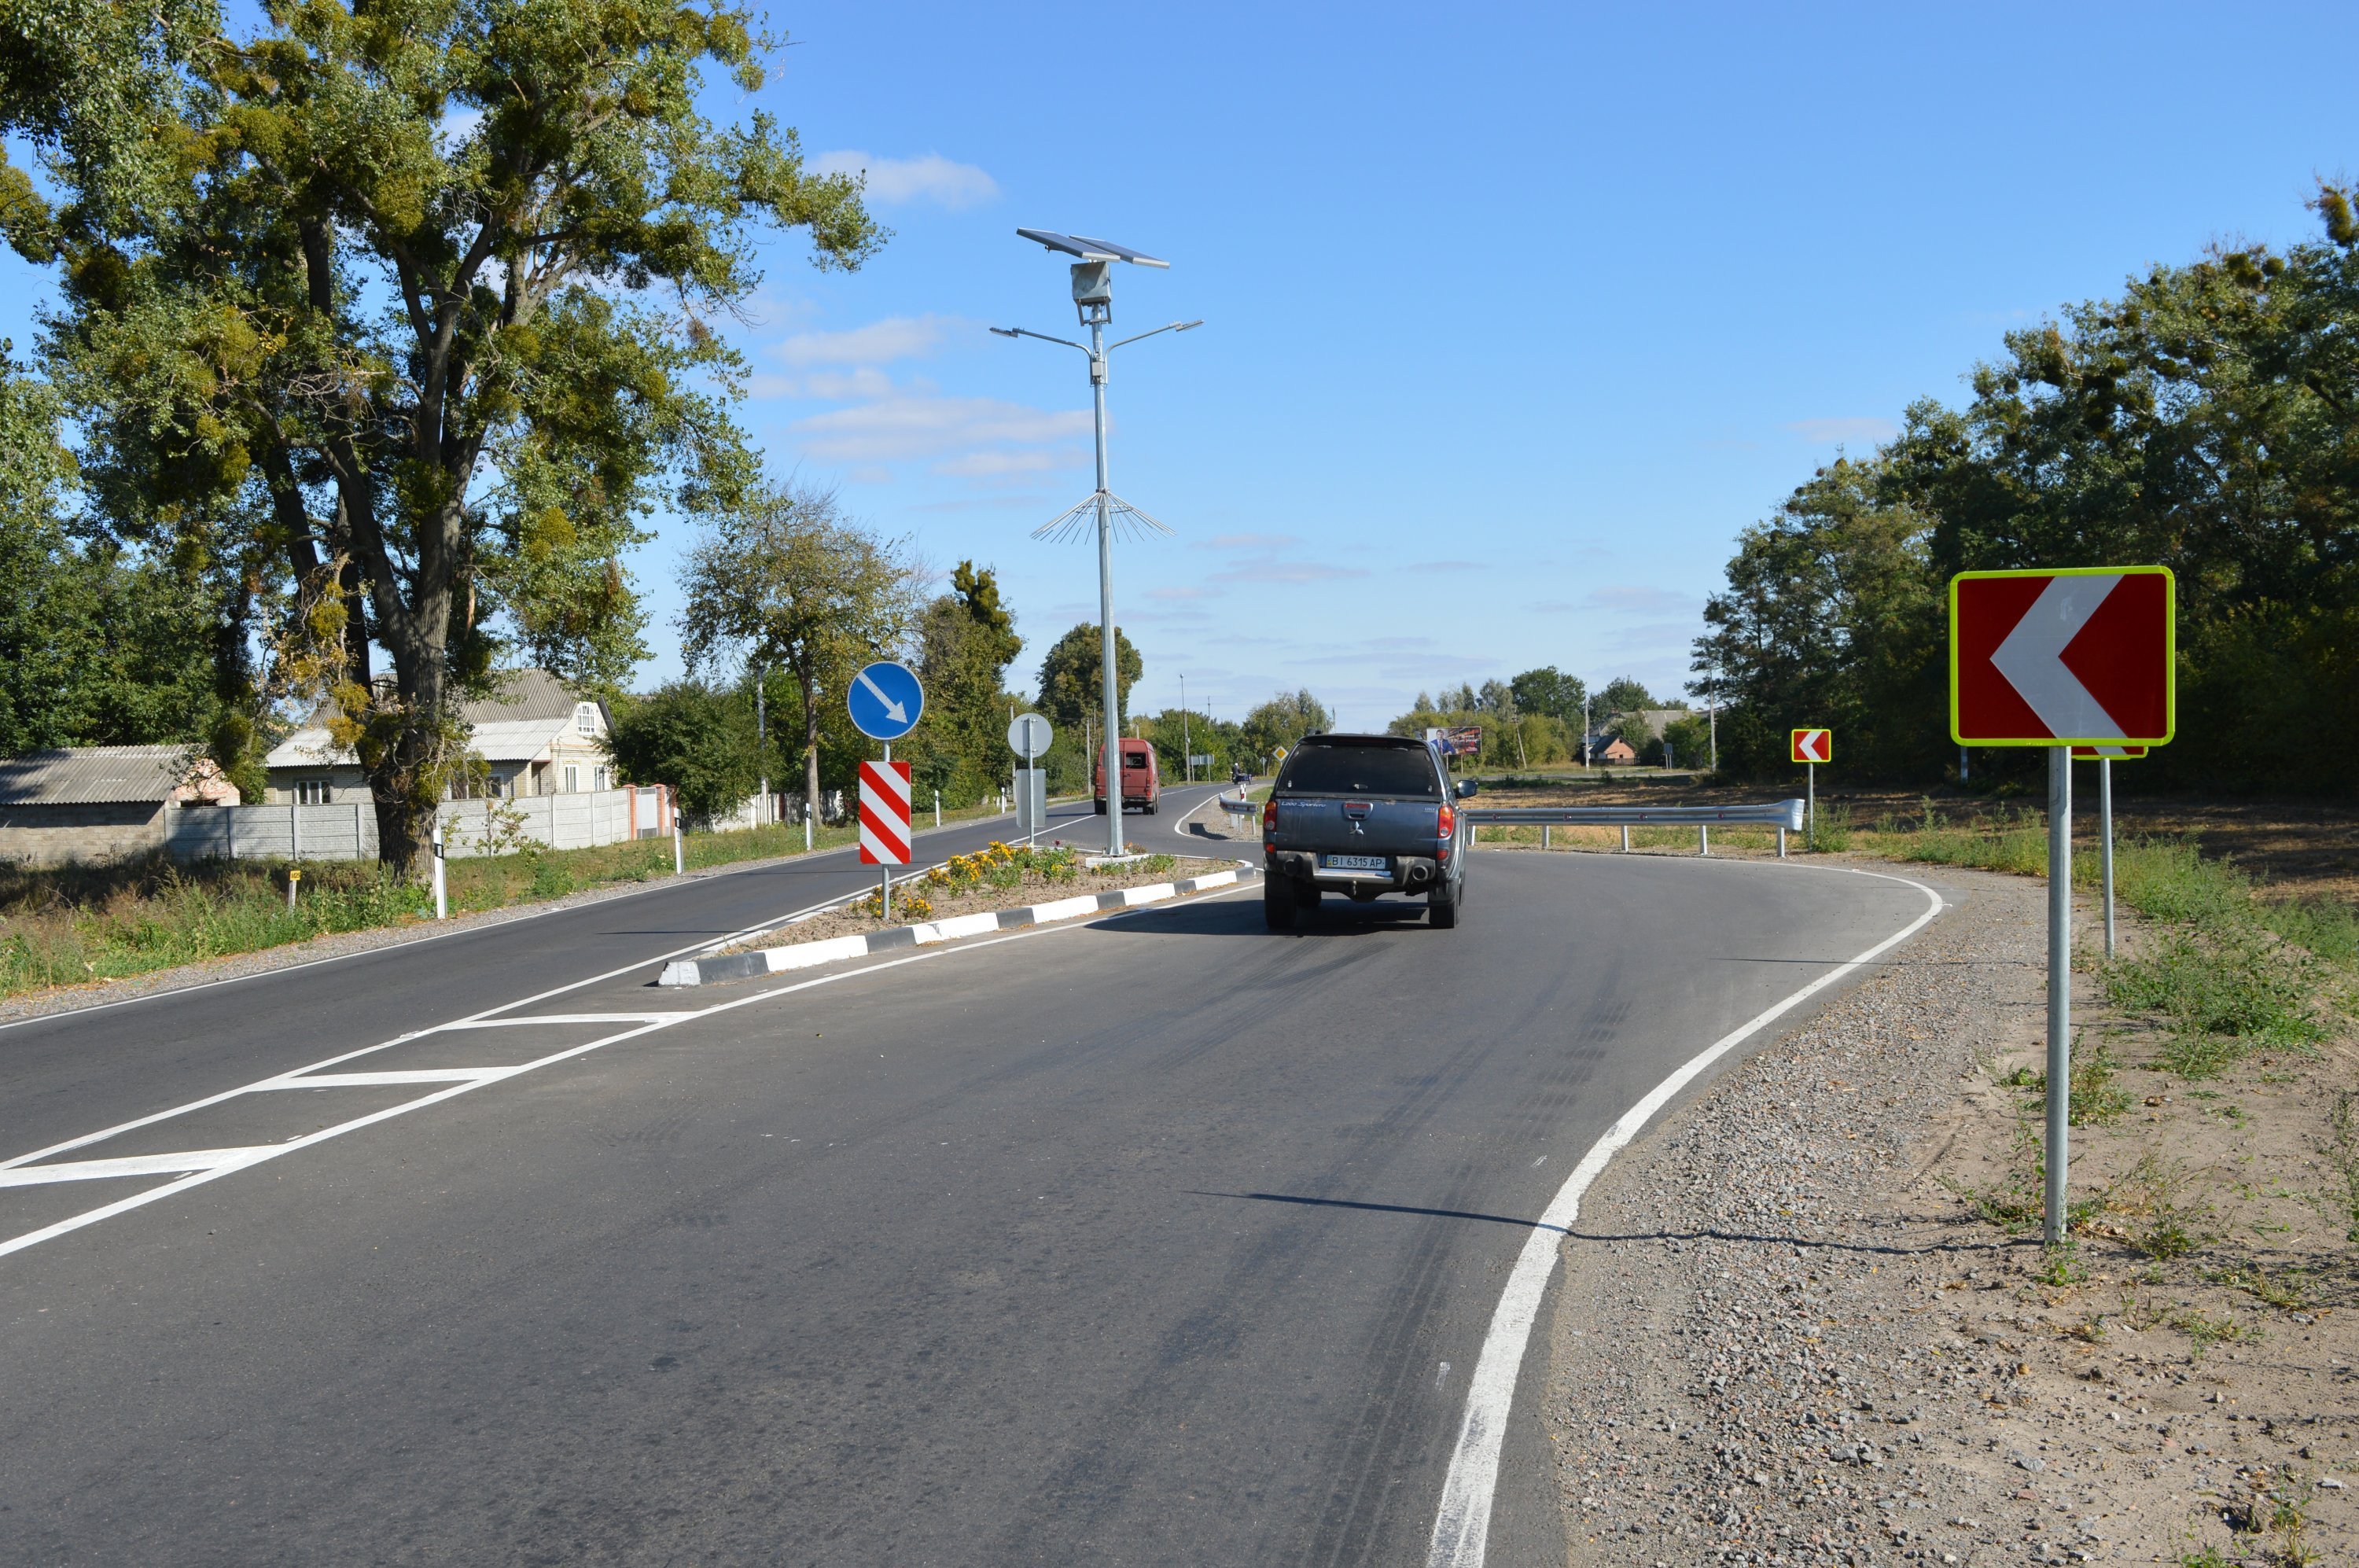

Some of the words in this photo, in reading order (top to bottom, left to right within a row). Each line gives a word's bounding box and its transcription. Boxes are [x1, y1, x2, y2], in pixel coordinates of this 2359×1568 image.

[1332, 856, 1343, 866] BI
[1347, 857, 1367, 867] 6315
[1370, 858, 1382, 867] AP
